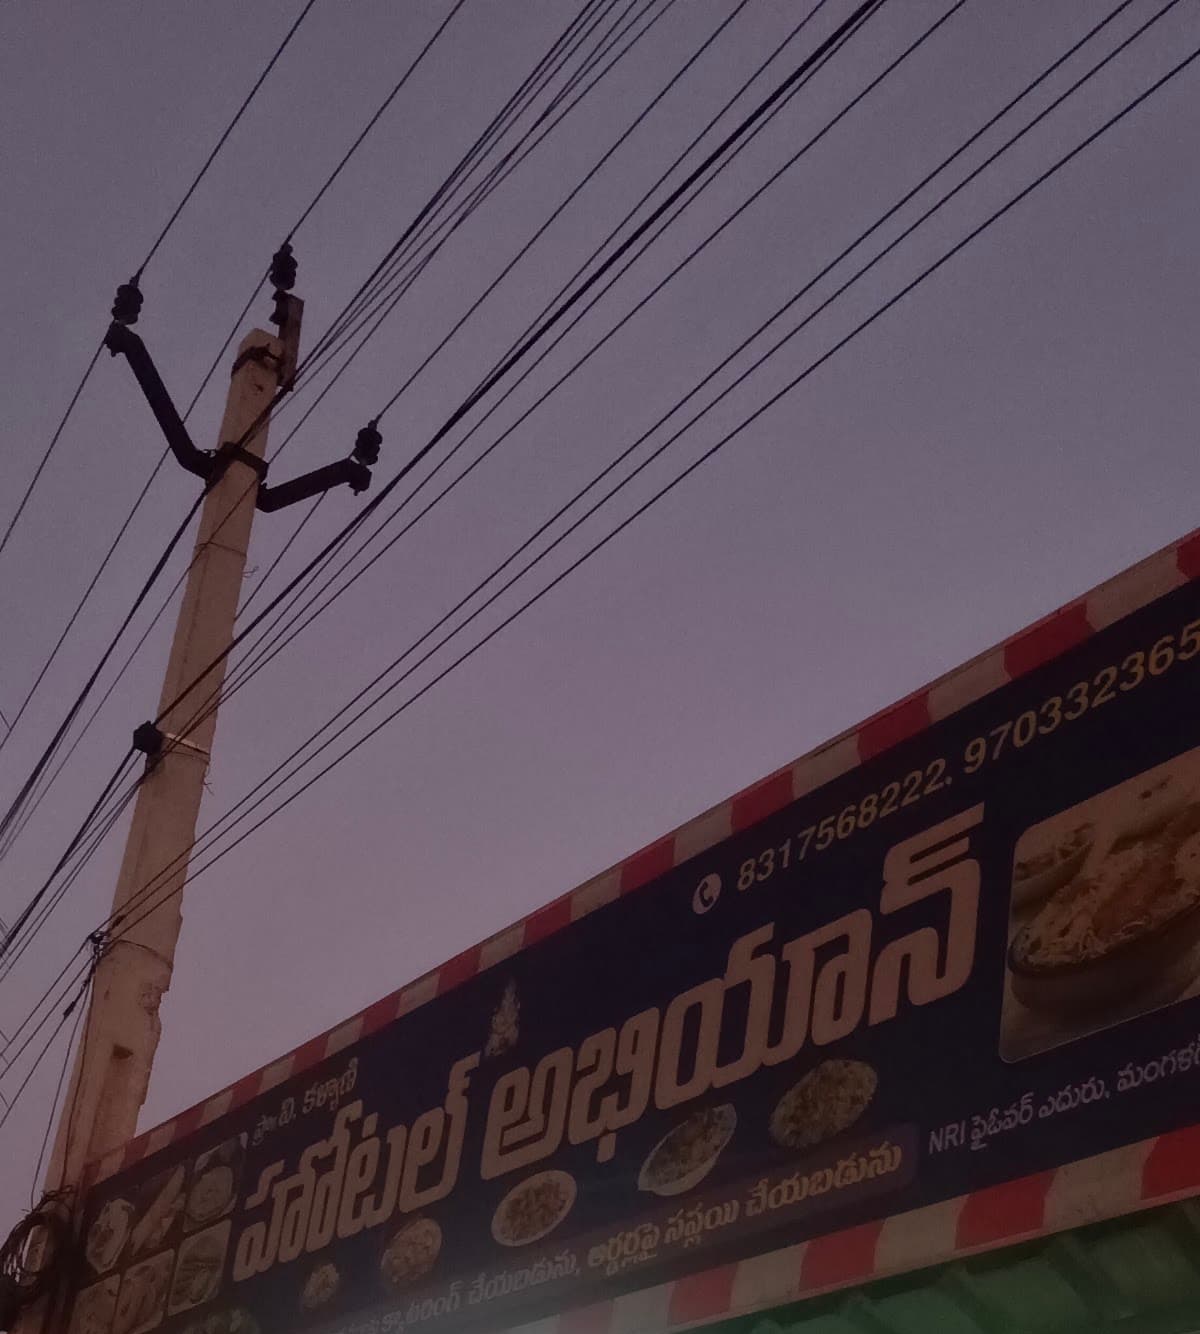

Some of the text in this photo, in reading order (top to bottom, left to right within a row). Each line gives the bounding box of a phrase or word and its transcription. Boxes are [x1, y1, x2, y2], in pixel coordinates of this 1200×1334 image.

[232, 802, 985, 1283] హోటల్ అభియాన్
[928, 1119, 966, 1156] NRI
[745, 1140, 903, 1217] చేయబడును
